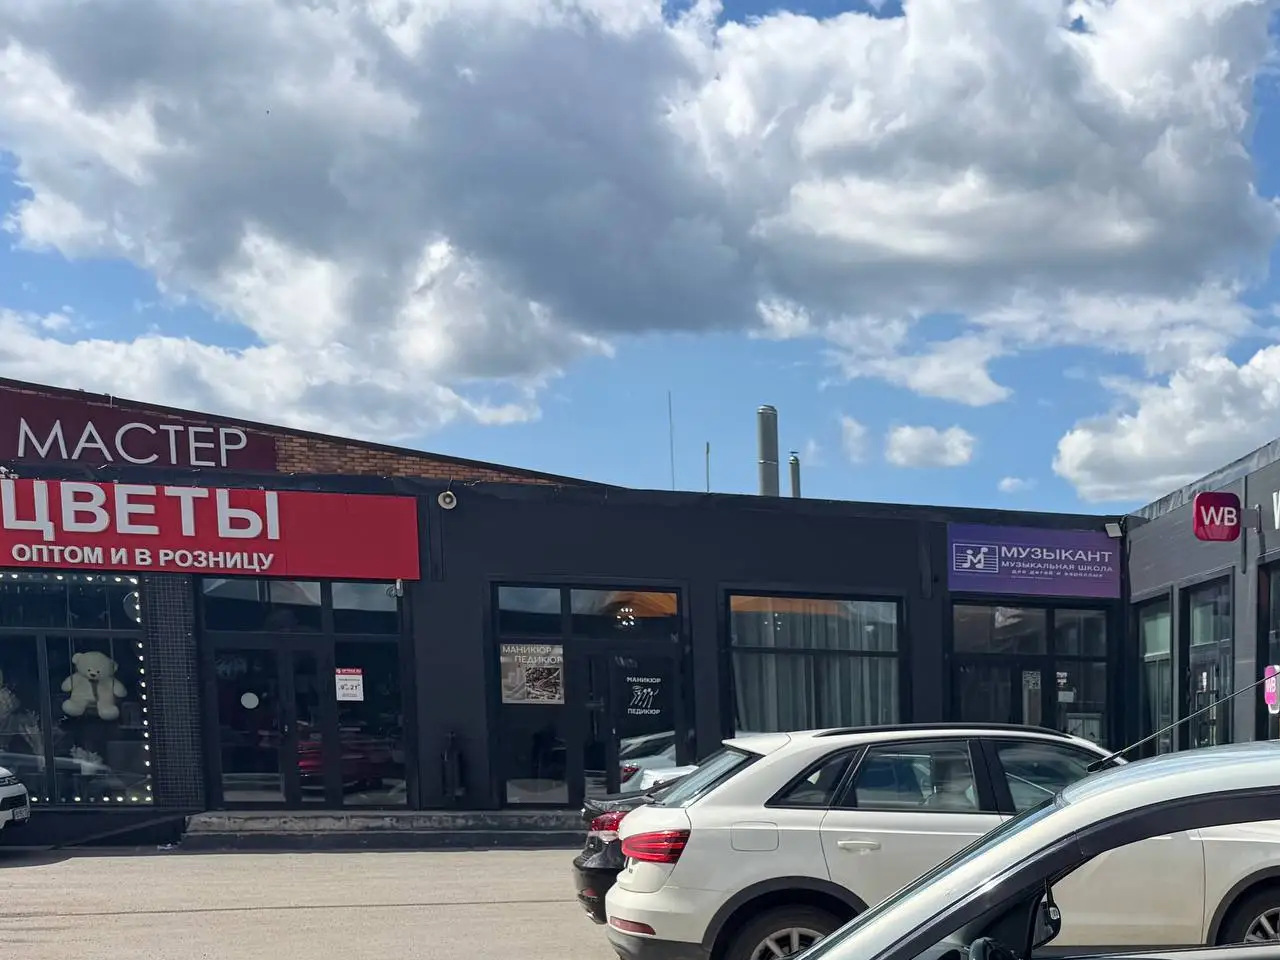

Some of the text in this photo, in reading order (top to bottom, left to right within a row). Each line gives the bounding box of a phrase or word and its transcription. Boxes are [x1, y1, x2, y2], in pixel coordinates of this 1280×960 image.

[17, 416, 248, 468] МАСТЕР
[0, 478, 281, 542] ЦВЕТЫ
[1200, 505, 1238, 526] WB
[11, 544, 275, 573] ОПТОМ И В РОЗНИЦУ
[1001, 546, 1113, 563] МУЗЫКАНТ
[1001, 561, 1113, 572] МУЗЫКАЛЬНАЯ ШКОЛА
[502, 645, 552, 655] МАНИКЮР
[514, 655, 563, 665] ПЕДИКЮР
[626, 676, 662, 684] МАНИКЮР
